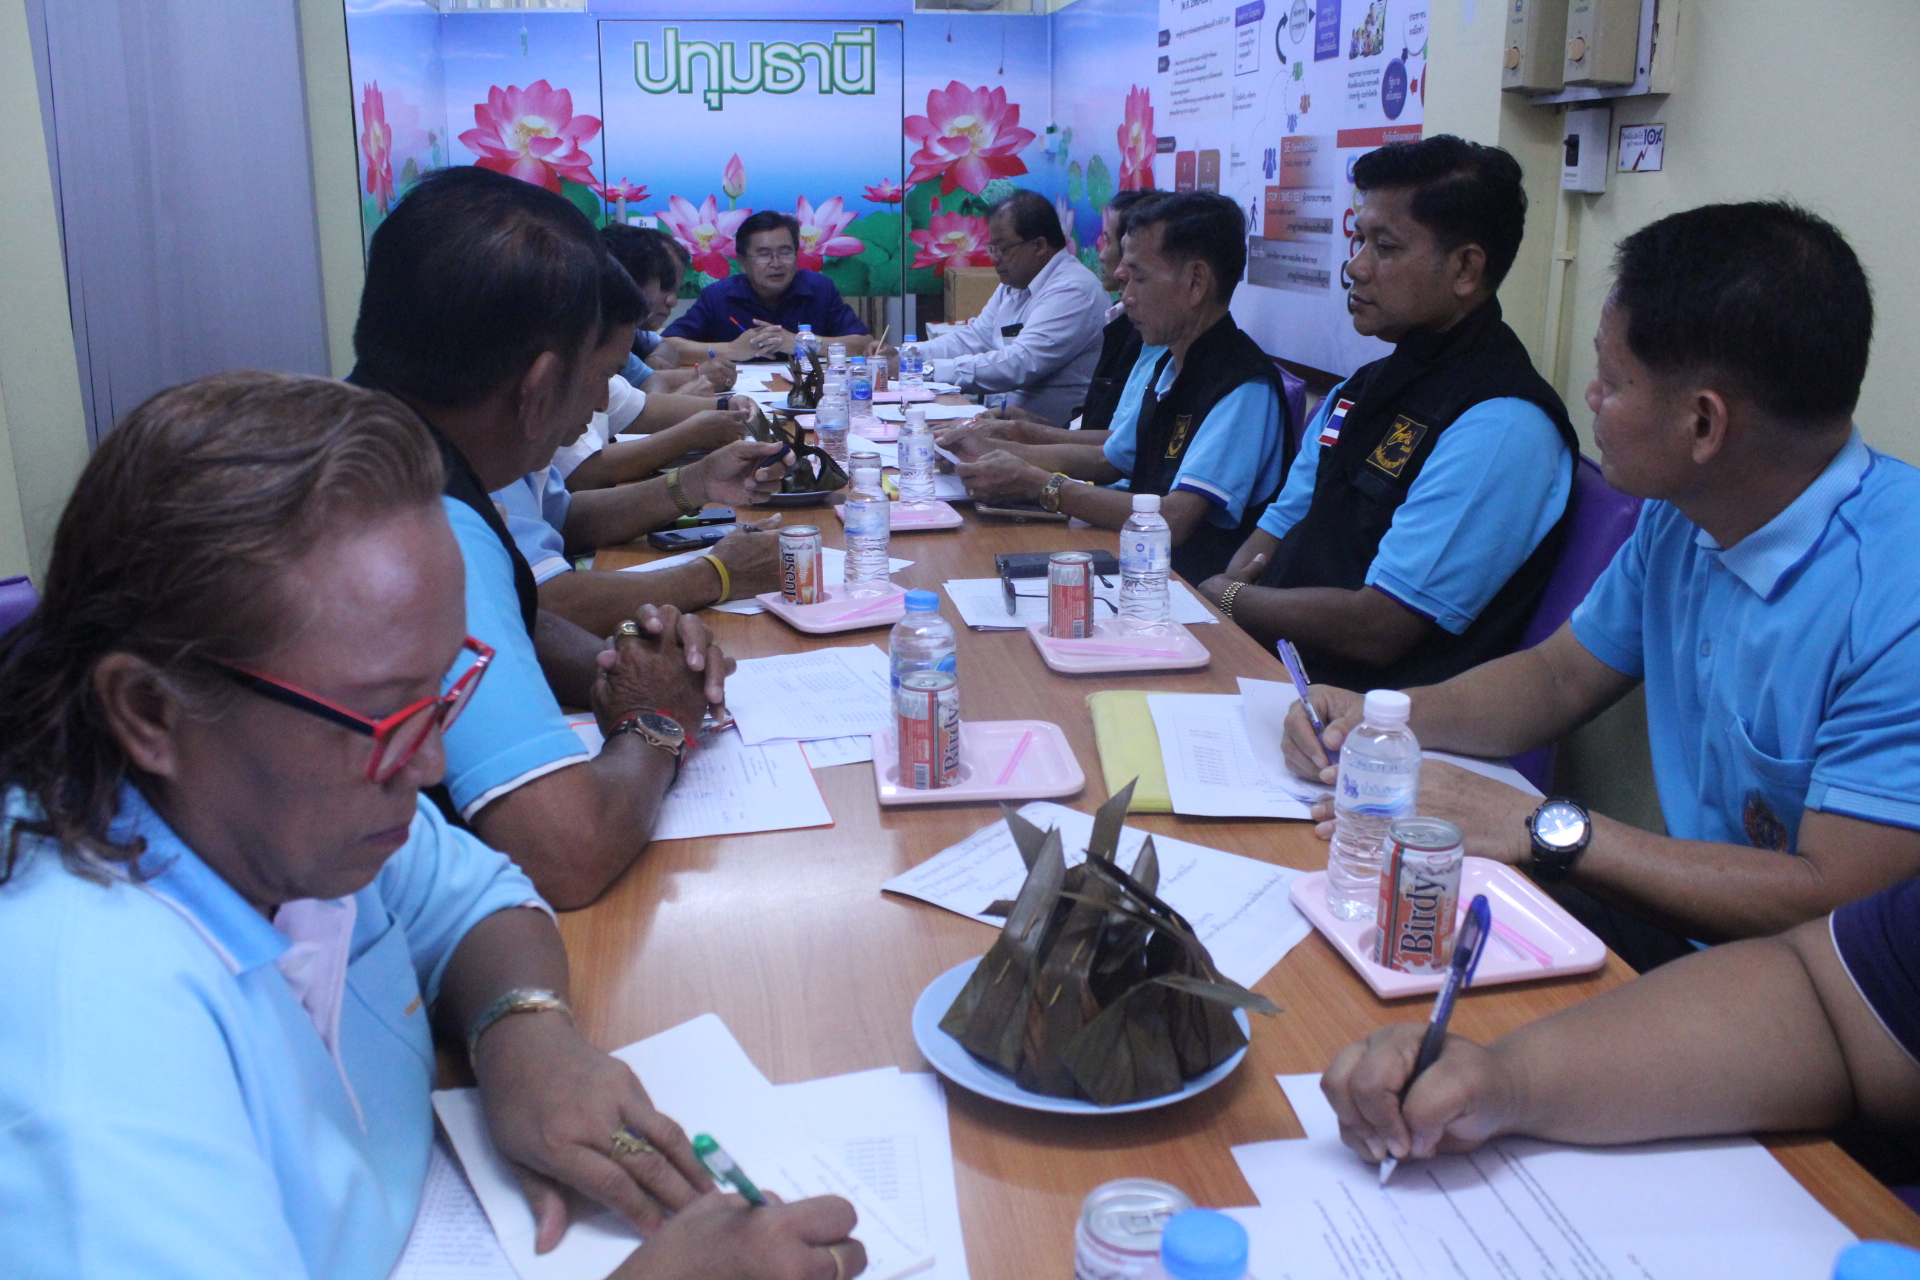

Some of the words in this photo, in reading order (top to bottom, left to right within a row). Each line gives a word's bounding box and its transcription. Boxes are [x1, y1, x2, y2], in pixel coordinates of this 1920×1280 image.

[634, 27, 876, 111] ปทุมธานี
[1643, 128, 1663, 146] 10%
[1399, 870, 1447, 957] Birdy
